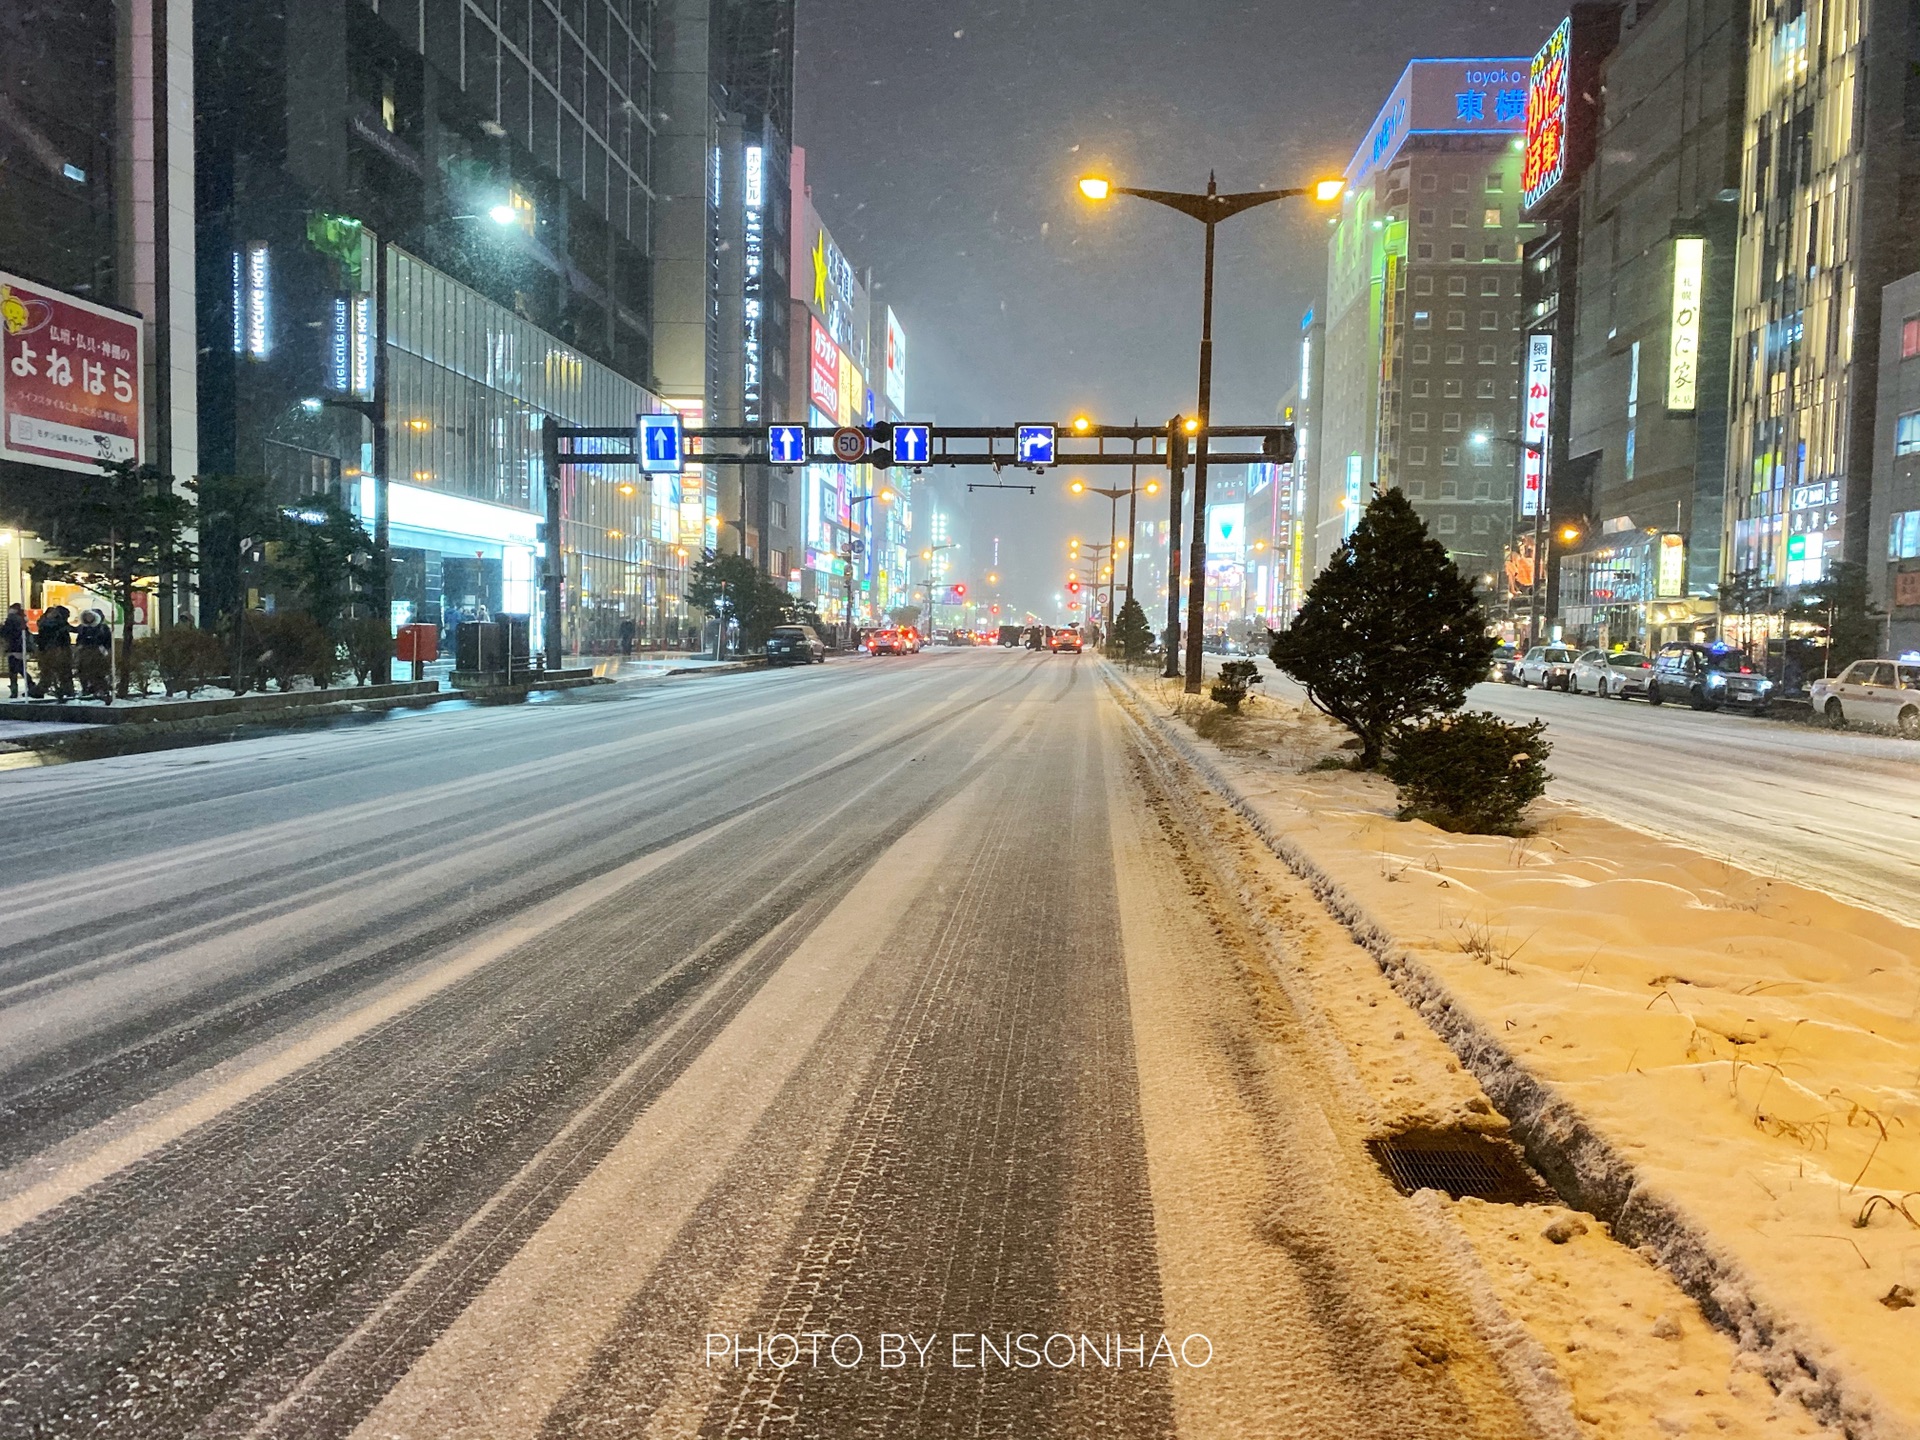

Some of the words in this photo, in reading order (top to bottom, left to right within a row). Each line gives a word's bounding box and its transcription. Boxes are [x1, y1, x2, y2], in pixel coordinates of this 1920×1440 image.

[1455, 88, 1527, 123] 東横
[748, 153, 759, 200] ホシビル
[251, 250, 265, 288] HOTEL
[250, 290, 265, 353] Mercure
[356, 298, 368, 331] HOTEL
[356, 335, 368, 389] Mercure
[814, 327, 837, 369] カラオケ
[11, 340, 133, 403] よねはら
[840, 436, 858, 452] 50
